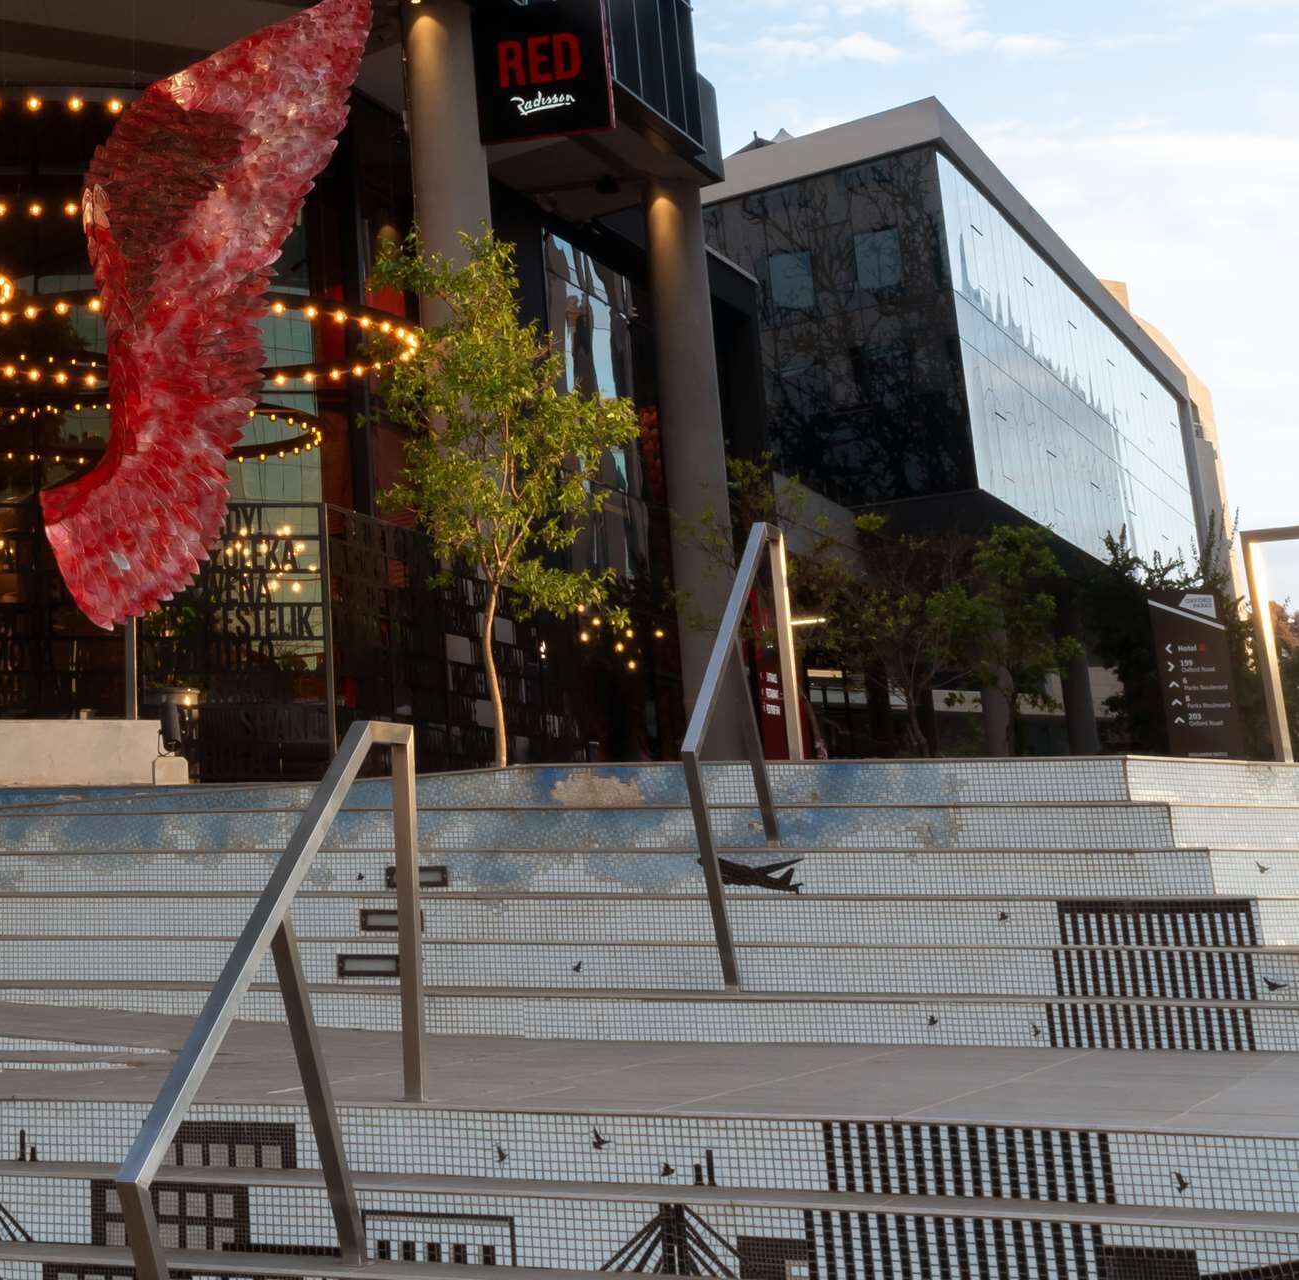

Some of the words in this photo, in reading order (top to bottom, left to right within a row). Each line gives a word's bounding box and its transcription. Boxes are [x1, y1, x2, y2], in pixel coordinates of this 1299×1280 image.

[497, 31, 582, 89] RED
[509, 89, 577, 117] Radisson
[1177, 644, 1198, 653] Hotel
